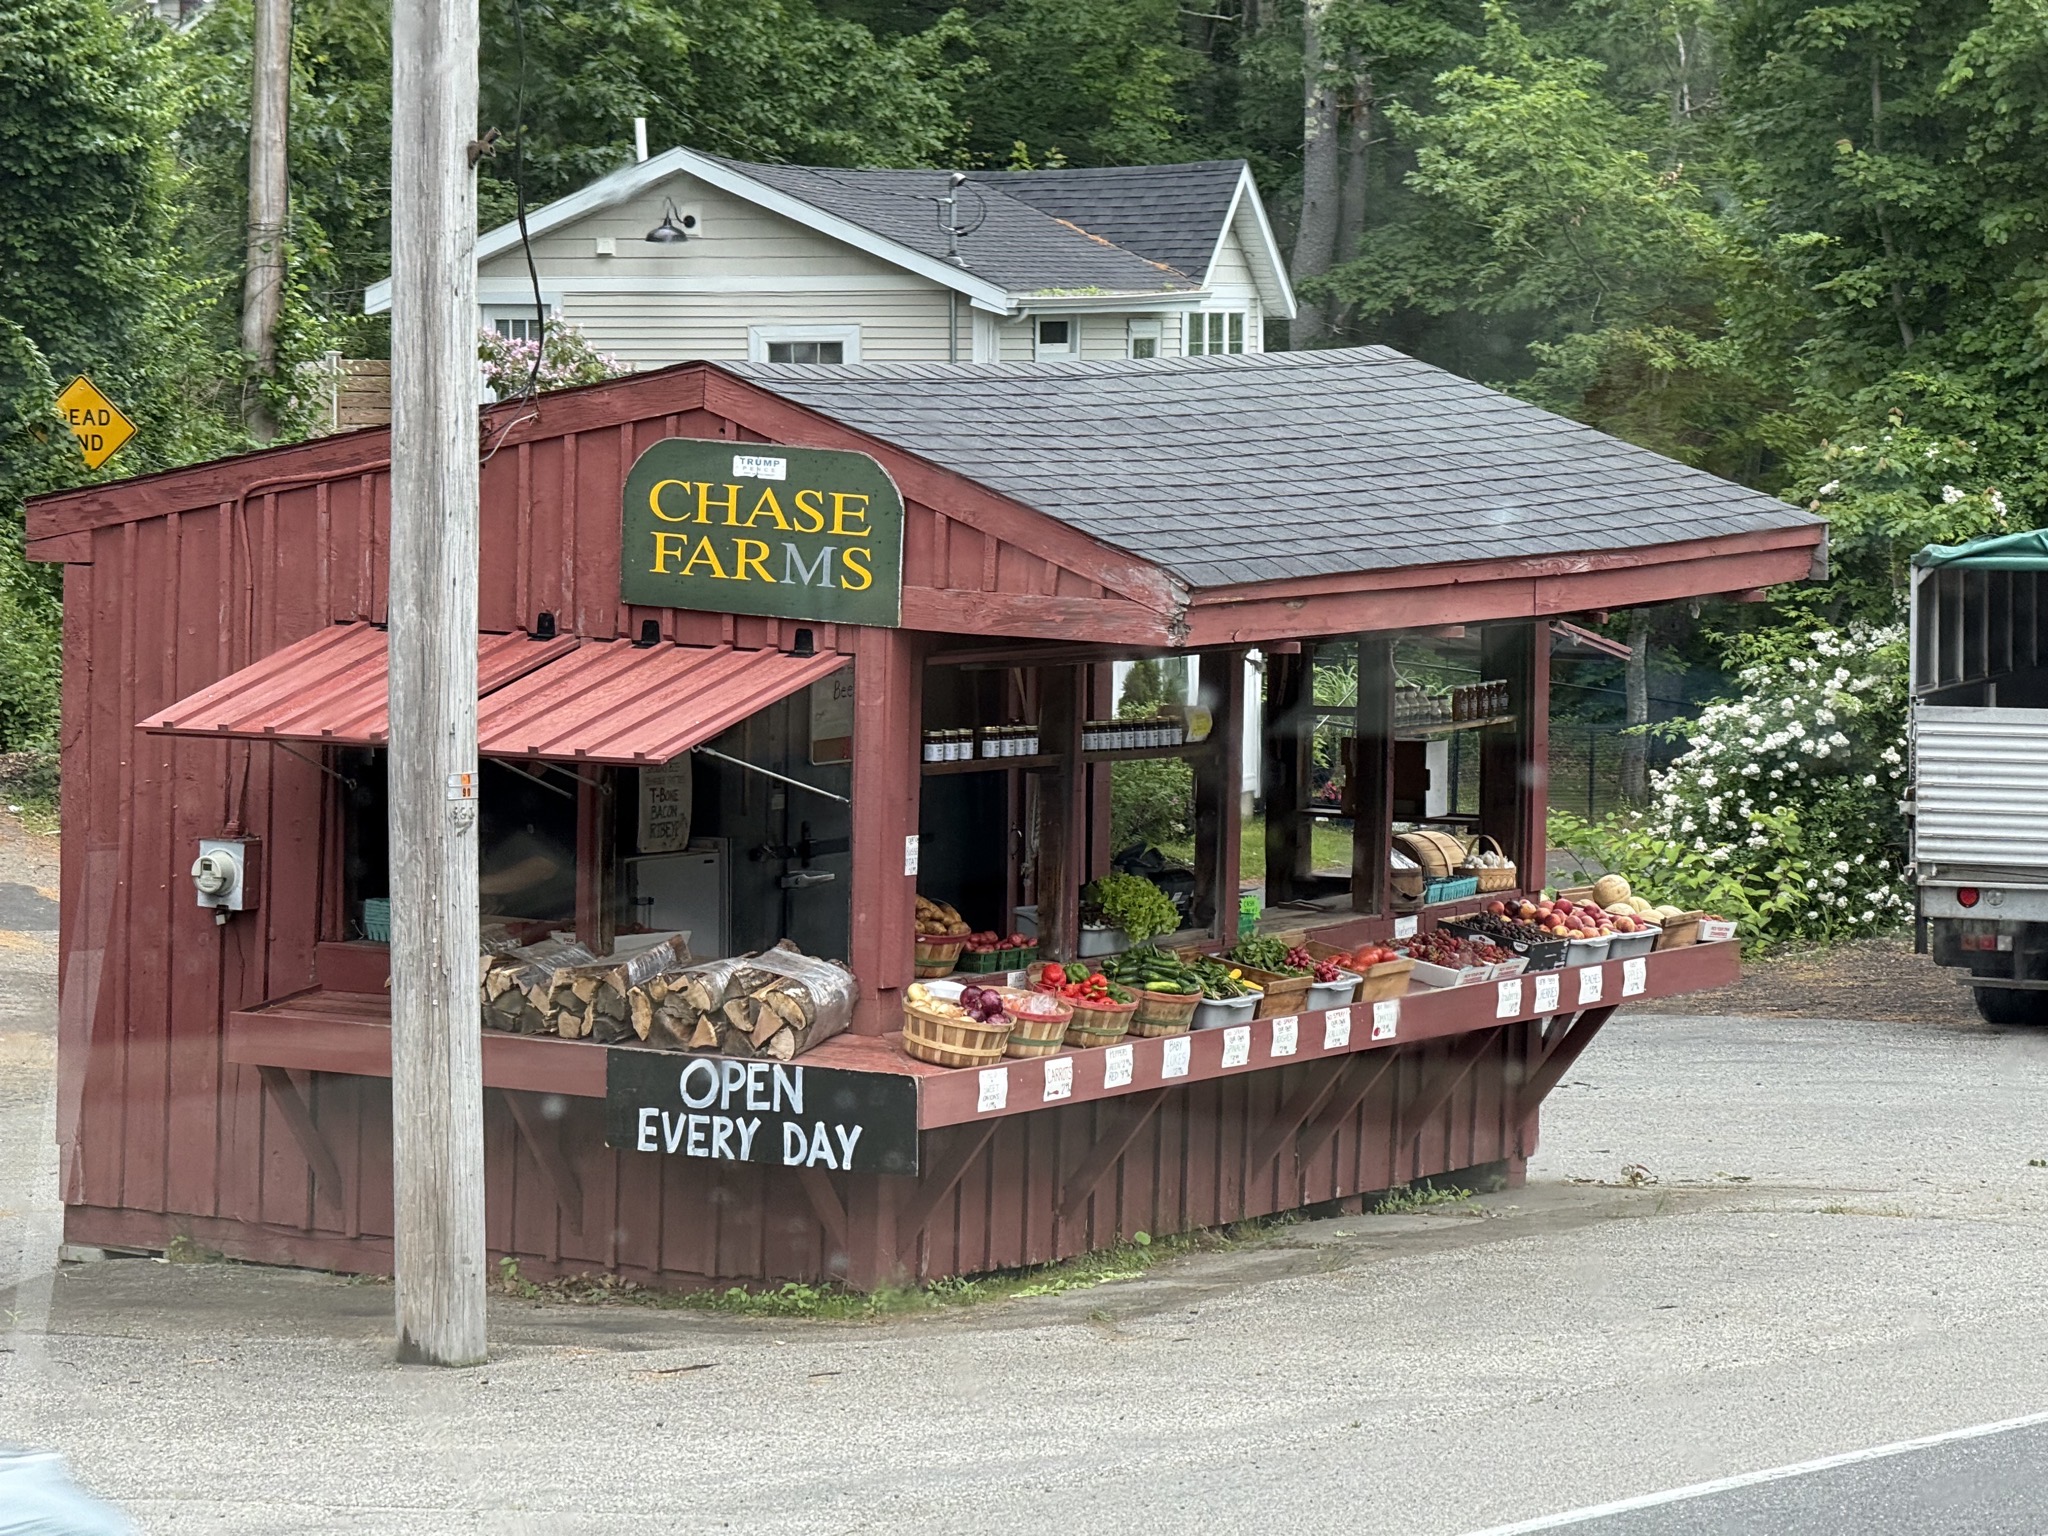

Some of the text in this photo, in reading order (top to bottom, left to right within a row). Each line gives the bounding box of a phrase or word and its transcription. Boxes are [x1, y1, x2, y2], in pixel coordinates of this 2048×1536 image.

[64, 409, 111, 426] EAD
[76, 434, 104, 451] ND
[740, 457, 780, 467] TRUMP
[649, 479, 872, 537] CHASE
[649, 531, 873, 590] FARMS
[651, 805, 678, 820] BACON
[1168, 1040, 1182, 1052] BABY
[1046, 1066, 1072, 1084] CARROTS
[680, 1058, 803, 1114] OPEN
[637, 1107, 863, 1170] EVERY DAY
